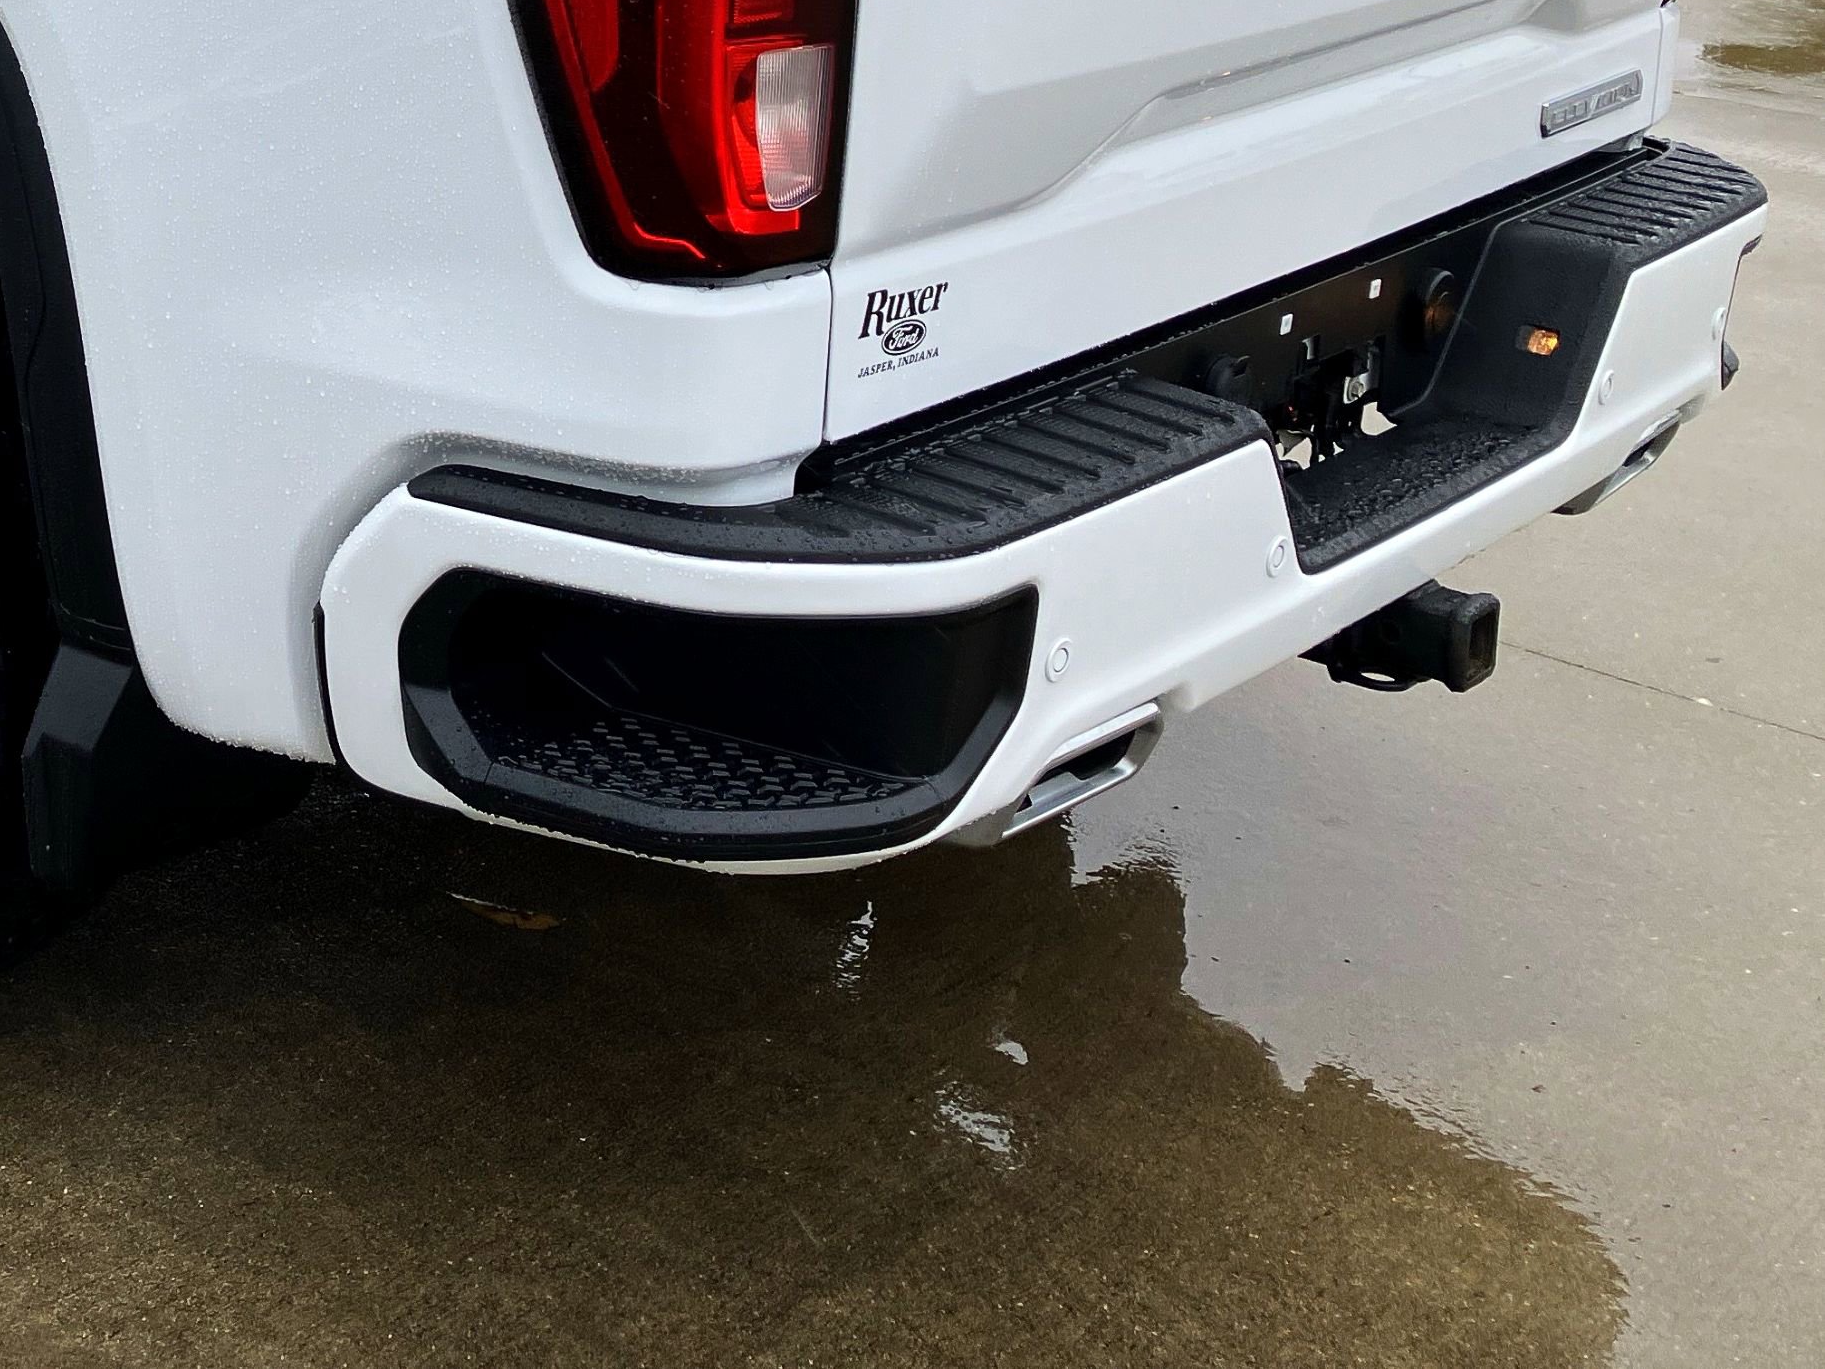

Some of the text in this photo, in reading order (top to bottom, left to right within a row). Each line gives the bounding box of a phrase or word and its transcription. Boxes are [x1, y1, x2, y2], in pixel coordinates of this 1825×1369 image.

[857, 281, 949, 340] Ruxer
[888, 324, 921, 351] Ford
[857, 347, 940, 379] JASPER, INDIANA
